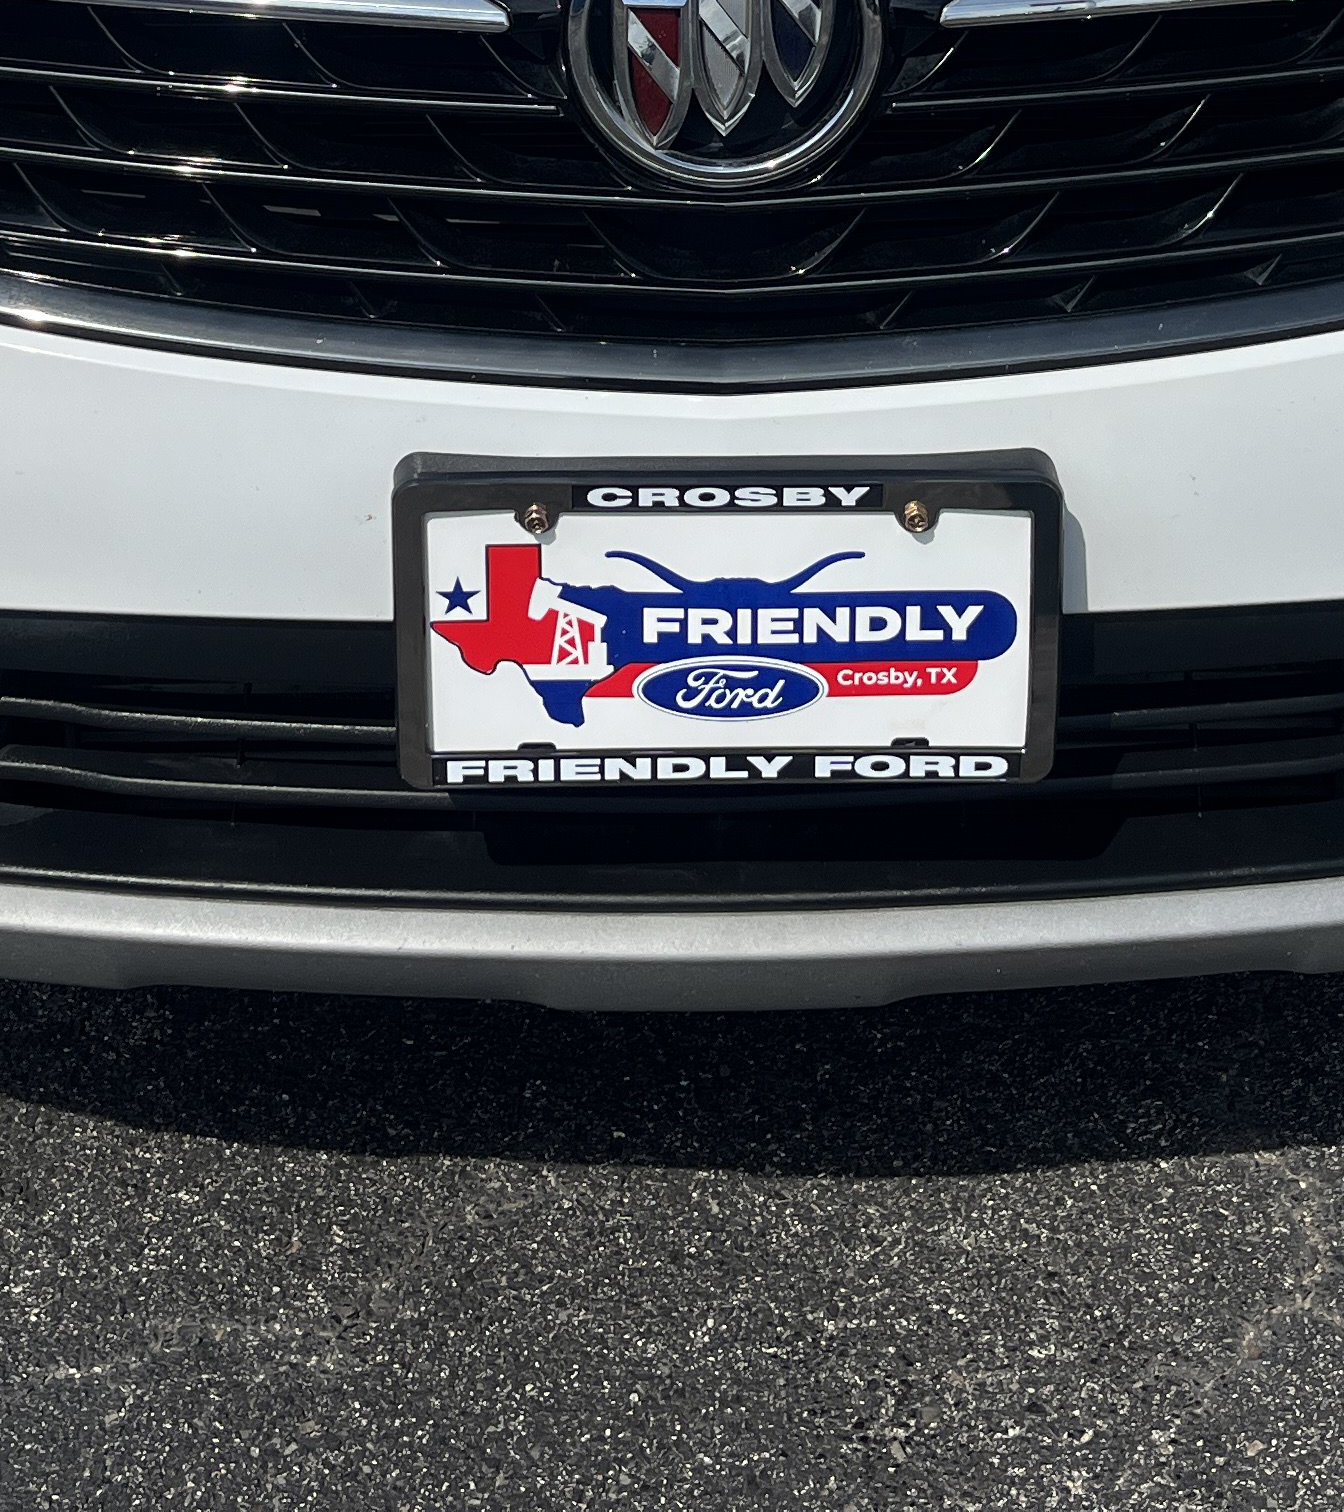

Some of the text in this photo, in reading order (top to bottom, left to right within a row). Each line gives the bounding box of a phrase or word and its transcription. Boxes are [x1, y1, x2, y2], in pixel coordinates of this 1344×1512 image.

[586, 486, 871, 507] CROSBY
[642, 606, 984, 645] FRIENDLY
[675, 670, 783, 711] Ford
[836, 666, 958, 688] Crosby, TX
[446, 755, 1009, 783] FRIENDLY FORD
